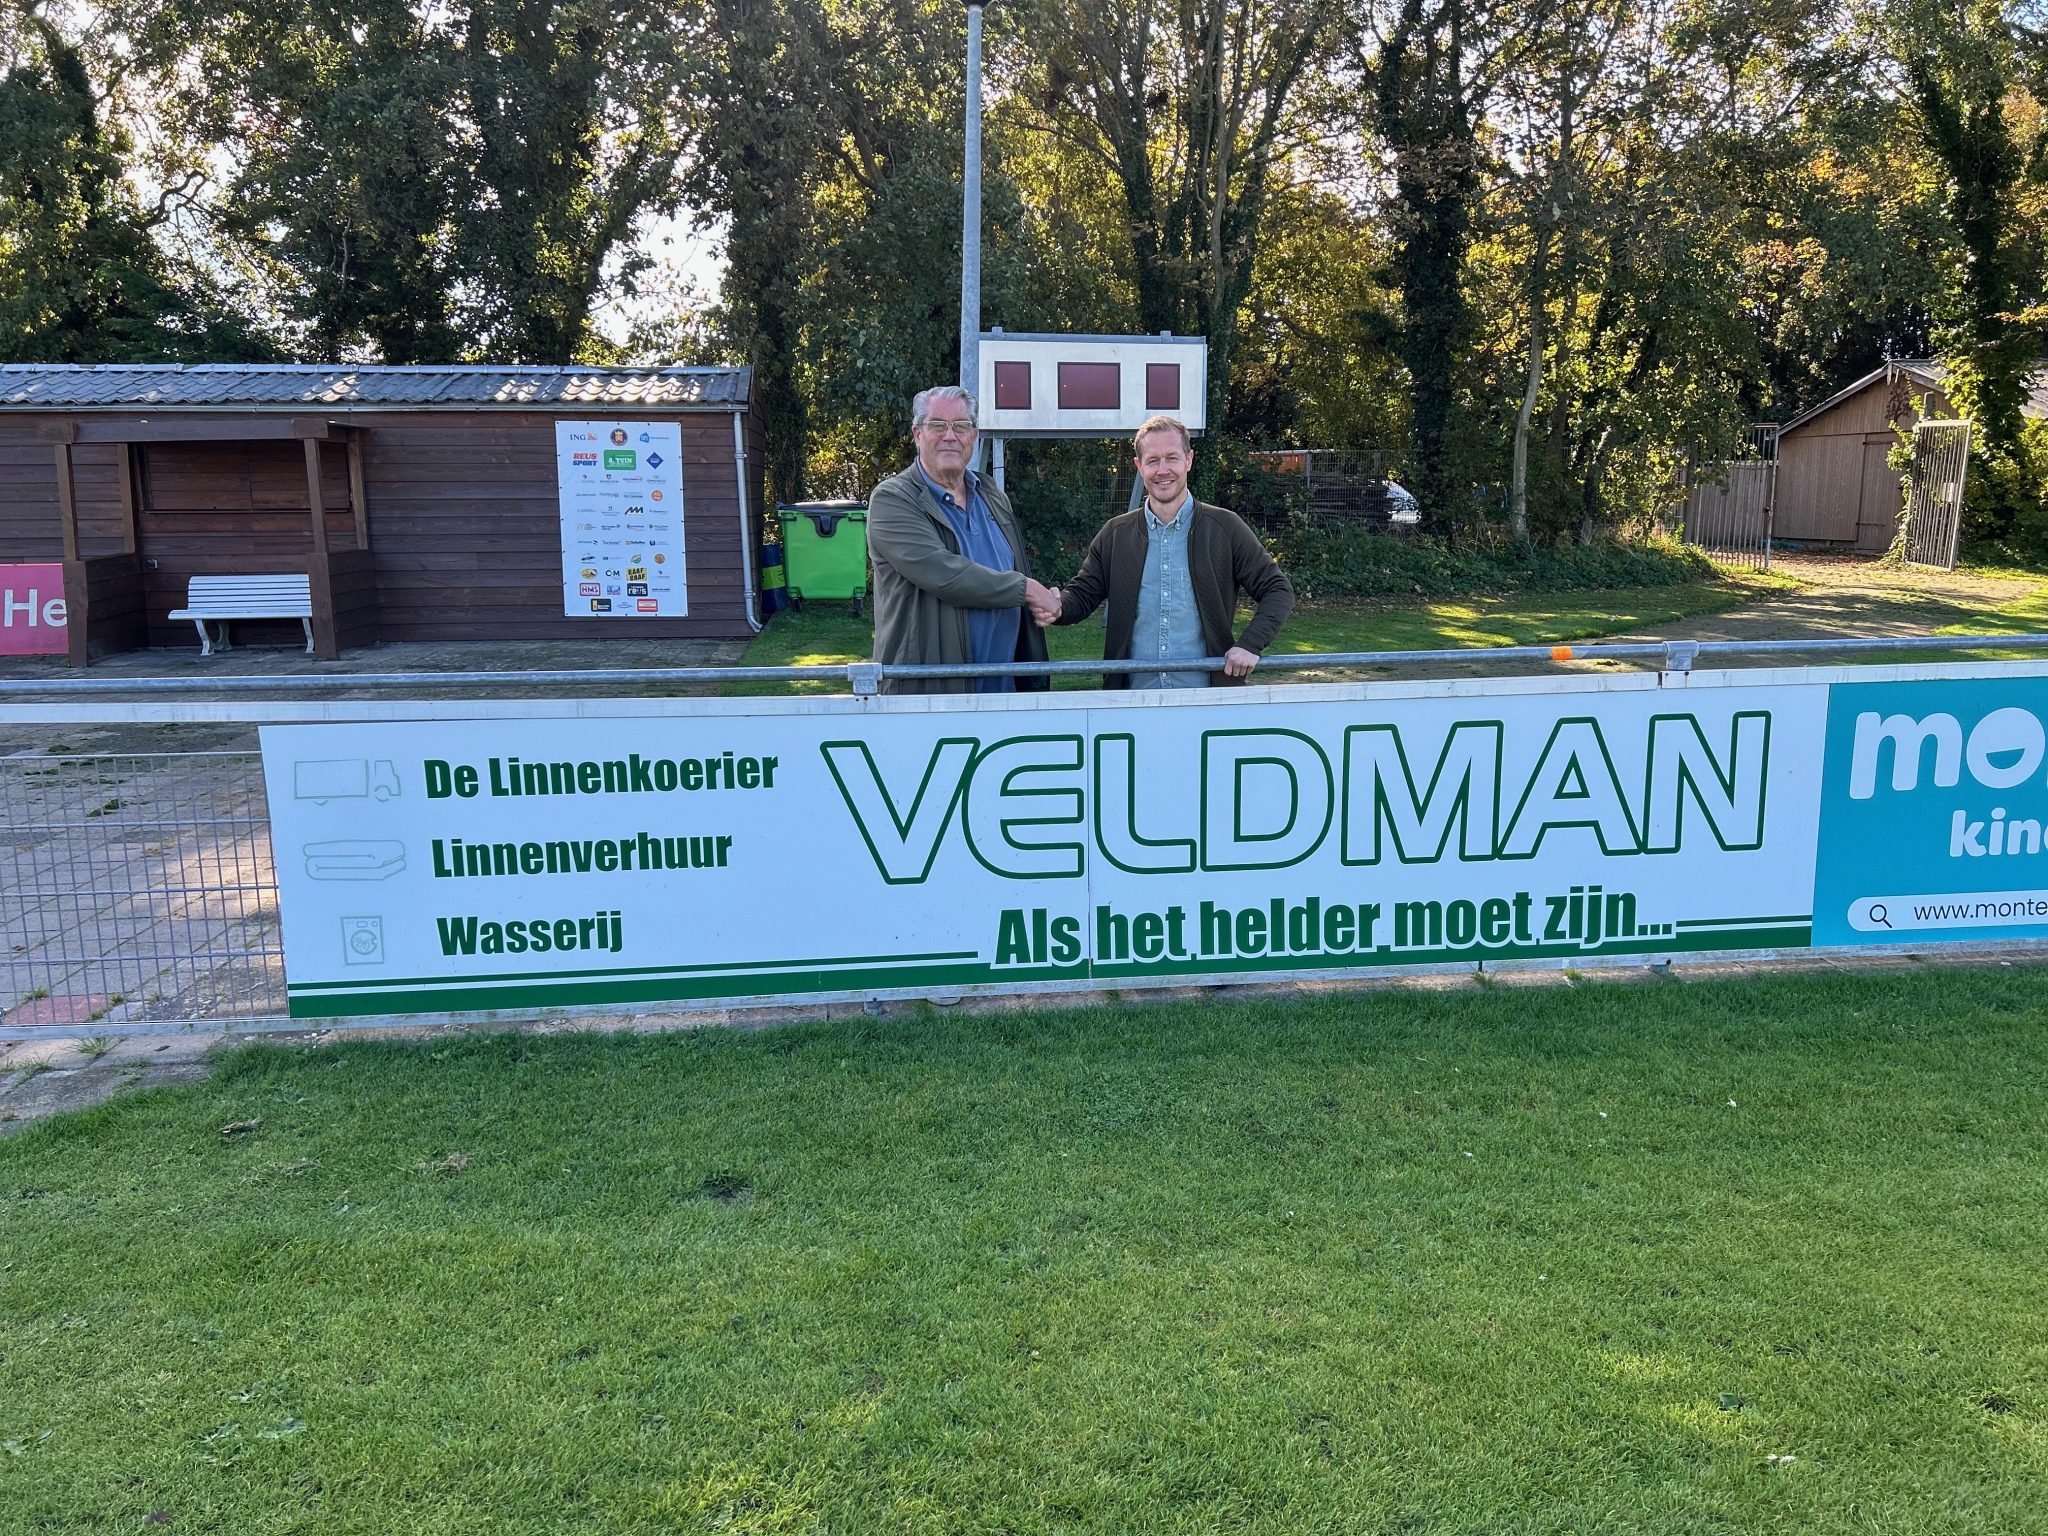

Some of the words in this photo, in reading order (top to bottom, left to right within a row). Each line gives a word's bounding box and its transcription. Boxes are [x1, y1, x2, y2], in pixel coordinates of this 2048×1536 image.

[423, 758, 479, 798] De
[488, 751, 779, 796] Linnenkoerier
[1850, 707, 2048, 799] mo
[820, 710, 1771, 884] VELDMAN
[432, 831, 733, 877] Linnenverhuur
[1950, 807, 2048, 857] kin
[436, 910, 623, 956] Wasserij
[998, 908, 1081, 963] Als
[1099, 904, 1187, 960] het
[1200, 896, 1381, 957] helder
[1394, 891, 1534, 946] moet
[1544, 885, 1673, 944] zijn...
[1914, 898, 2048, 920] www.monte
